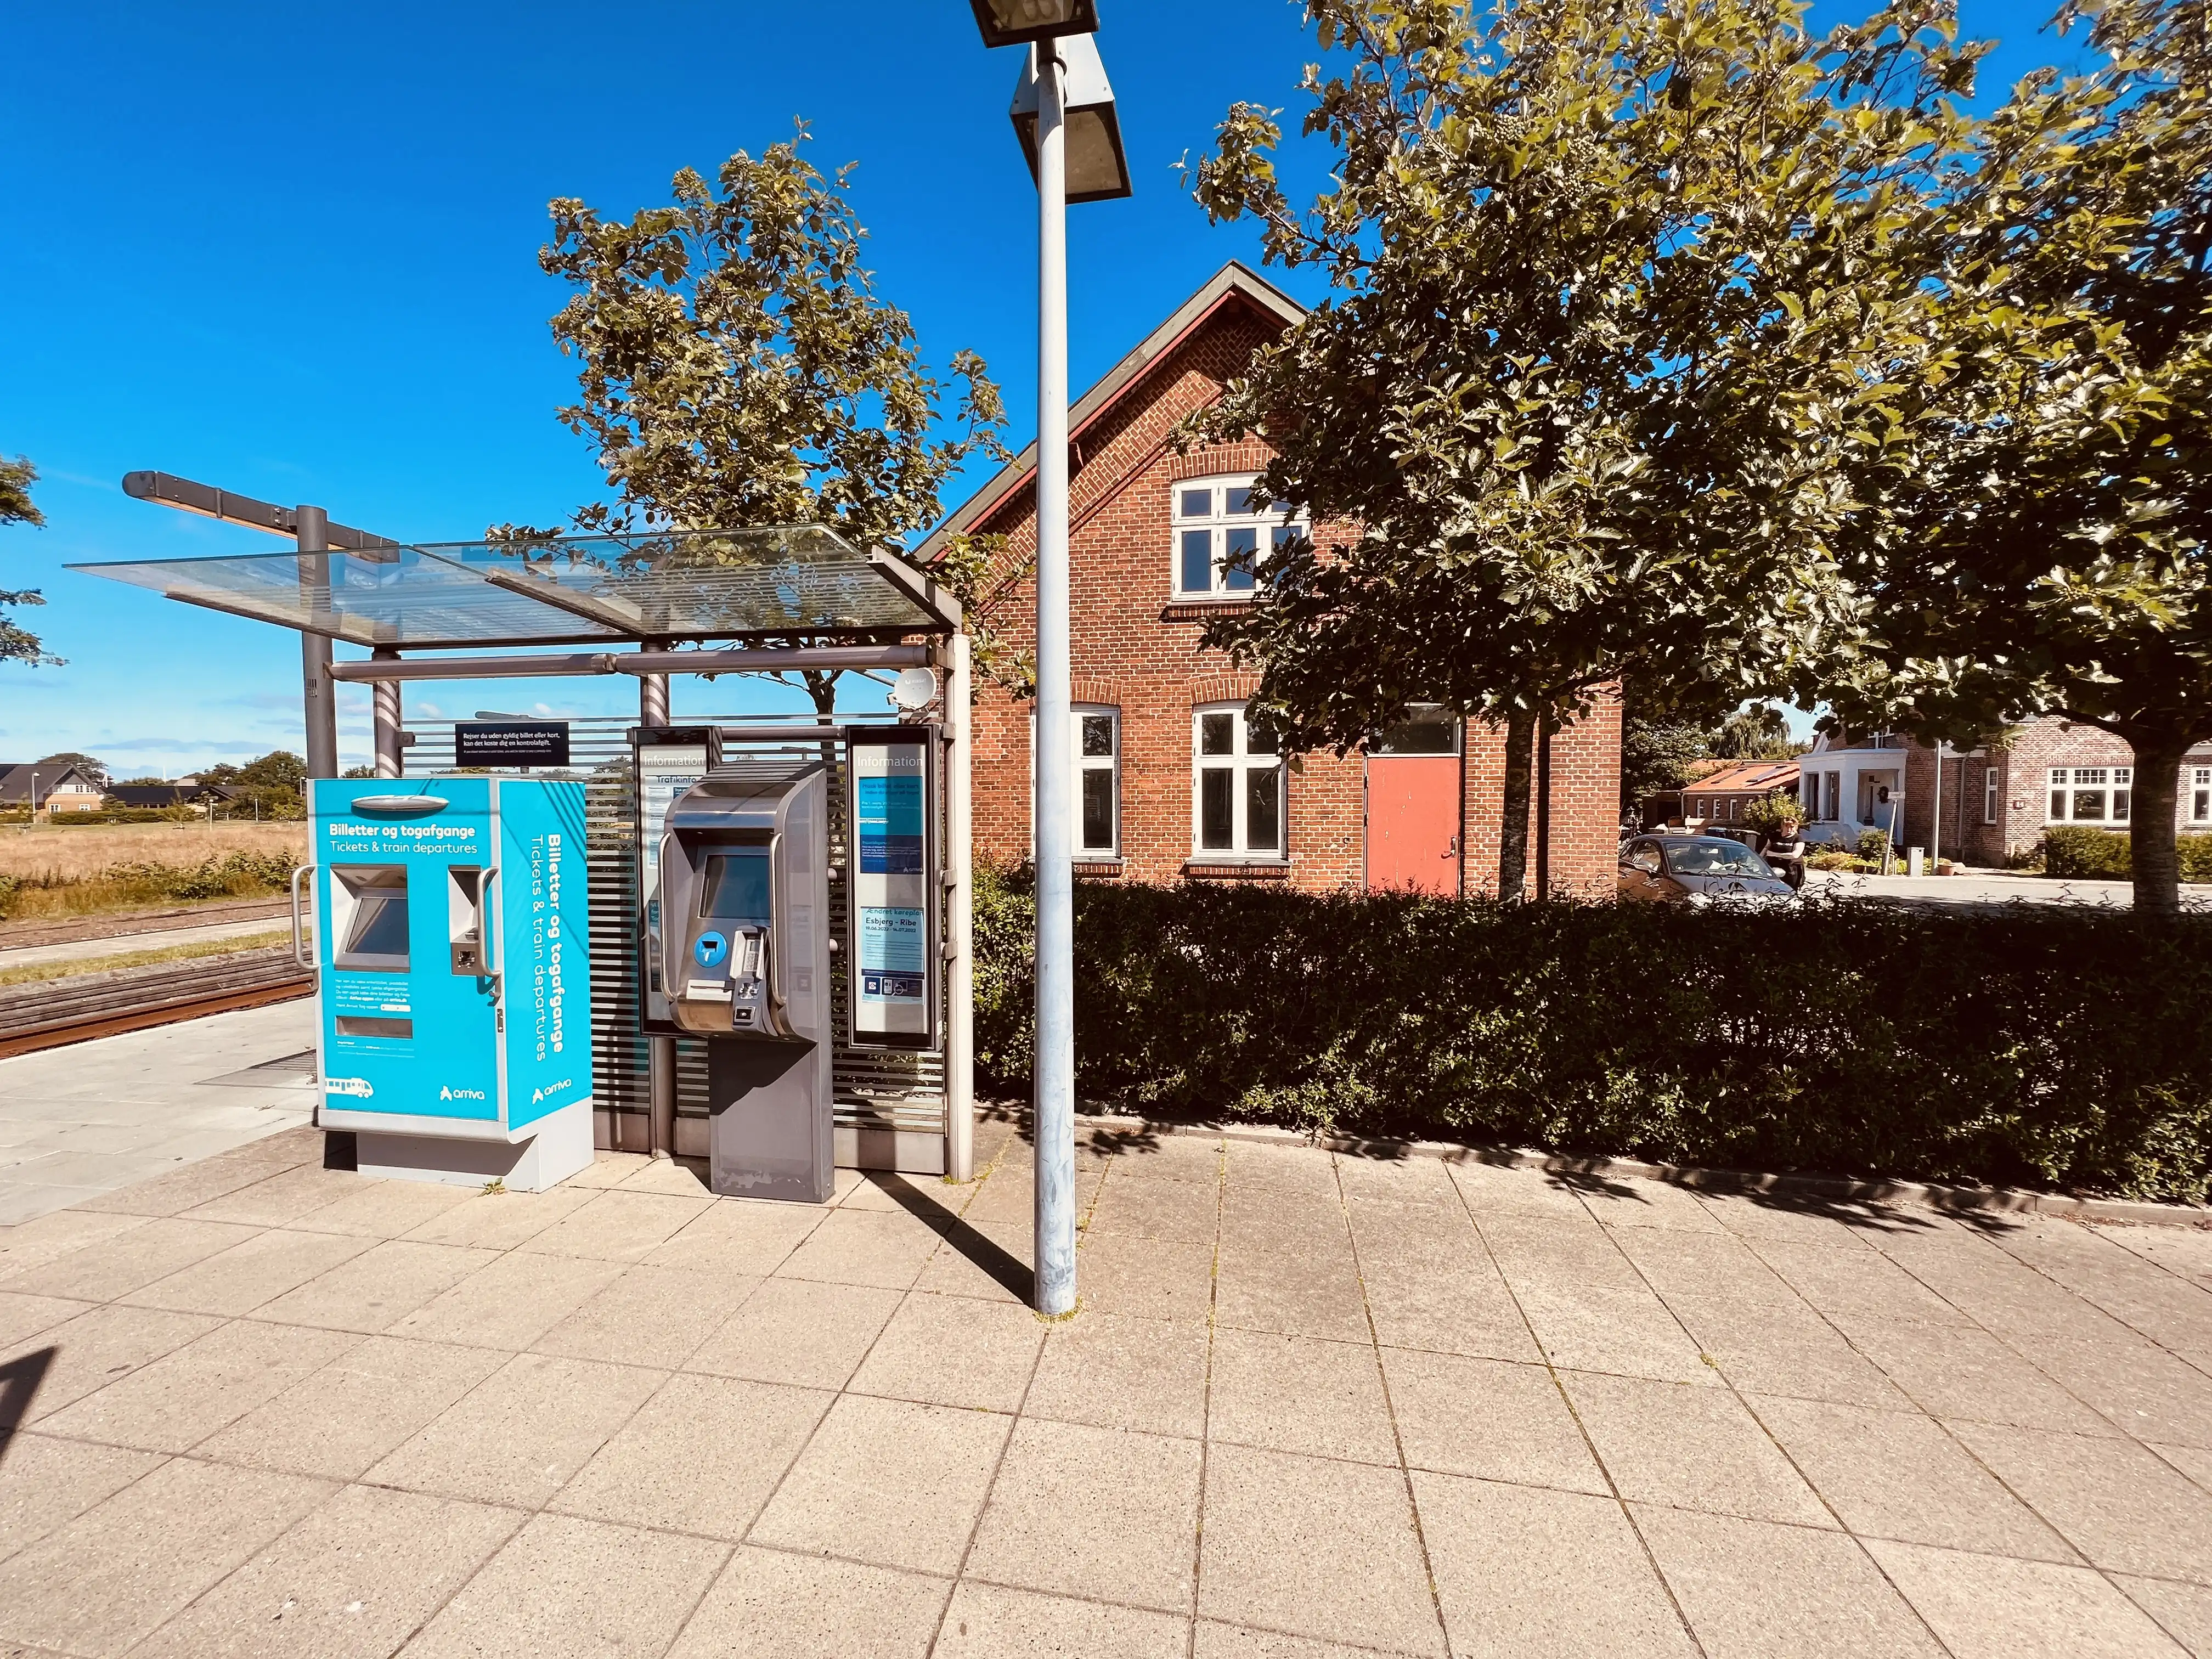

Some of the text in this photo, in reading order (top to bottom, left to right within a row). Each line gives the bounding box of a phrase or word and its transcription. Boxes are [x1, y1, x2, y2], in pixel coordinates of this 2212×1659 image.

[644, 755, 704, 766] Information
[857, 756, 923, 767] Information
[656, 775, 696, 783] Trafikinfo
[330, 823, 475, 840] Billetter og togafgange
[330, 840, 478, 855] Tickets & train departures
[866, 917, 893, 927] Esbjerg
[531, 834, 547, 1062] Tickets & train departures
[548, 834, 565, 1053] Billetter og togafgange
[453, 1088, 485, 1100] arriva
[544, 1079, 572, 1096] arriva
